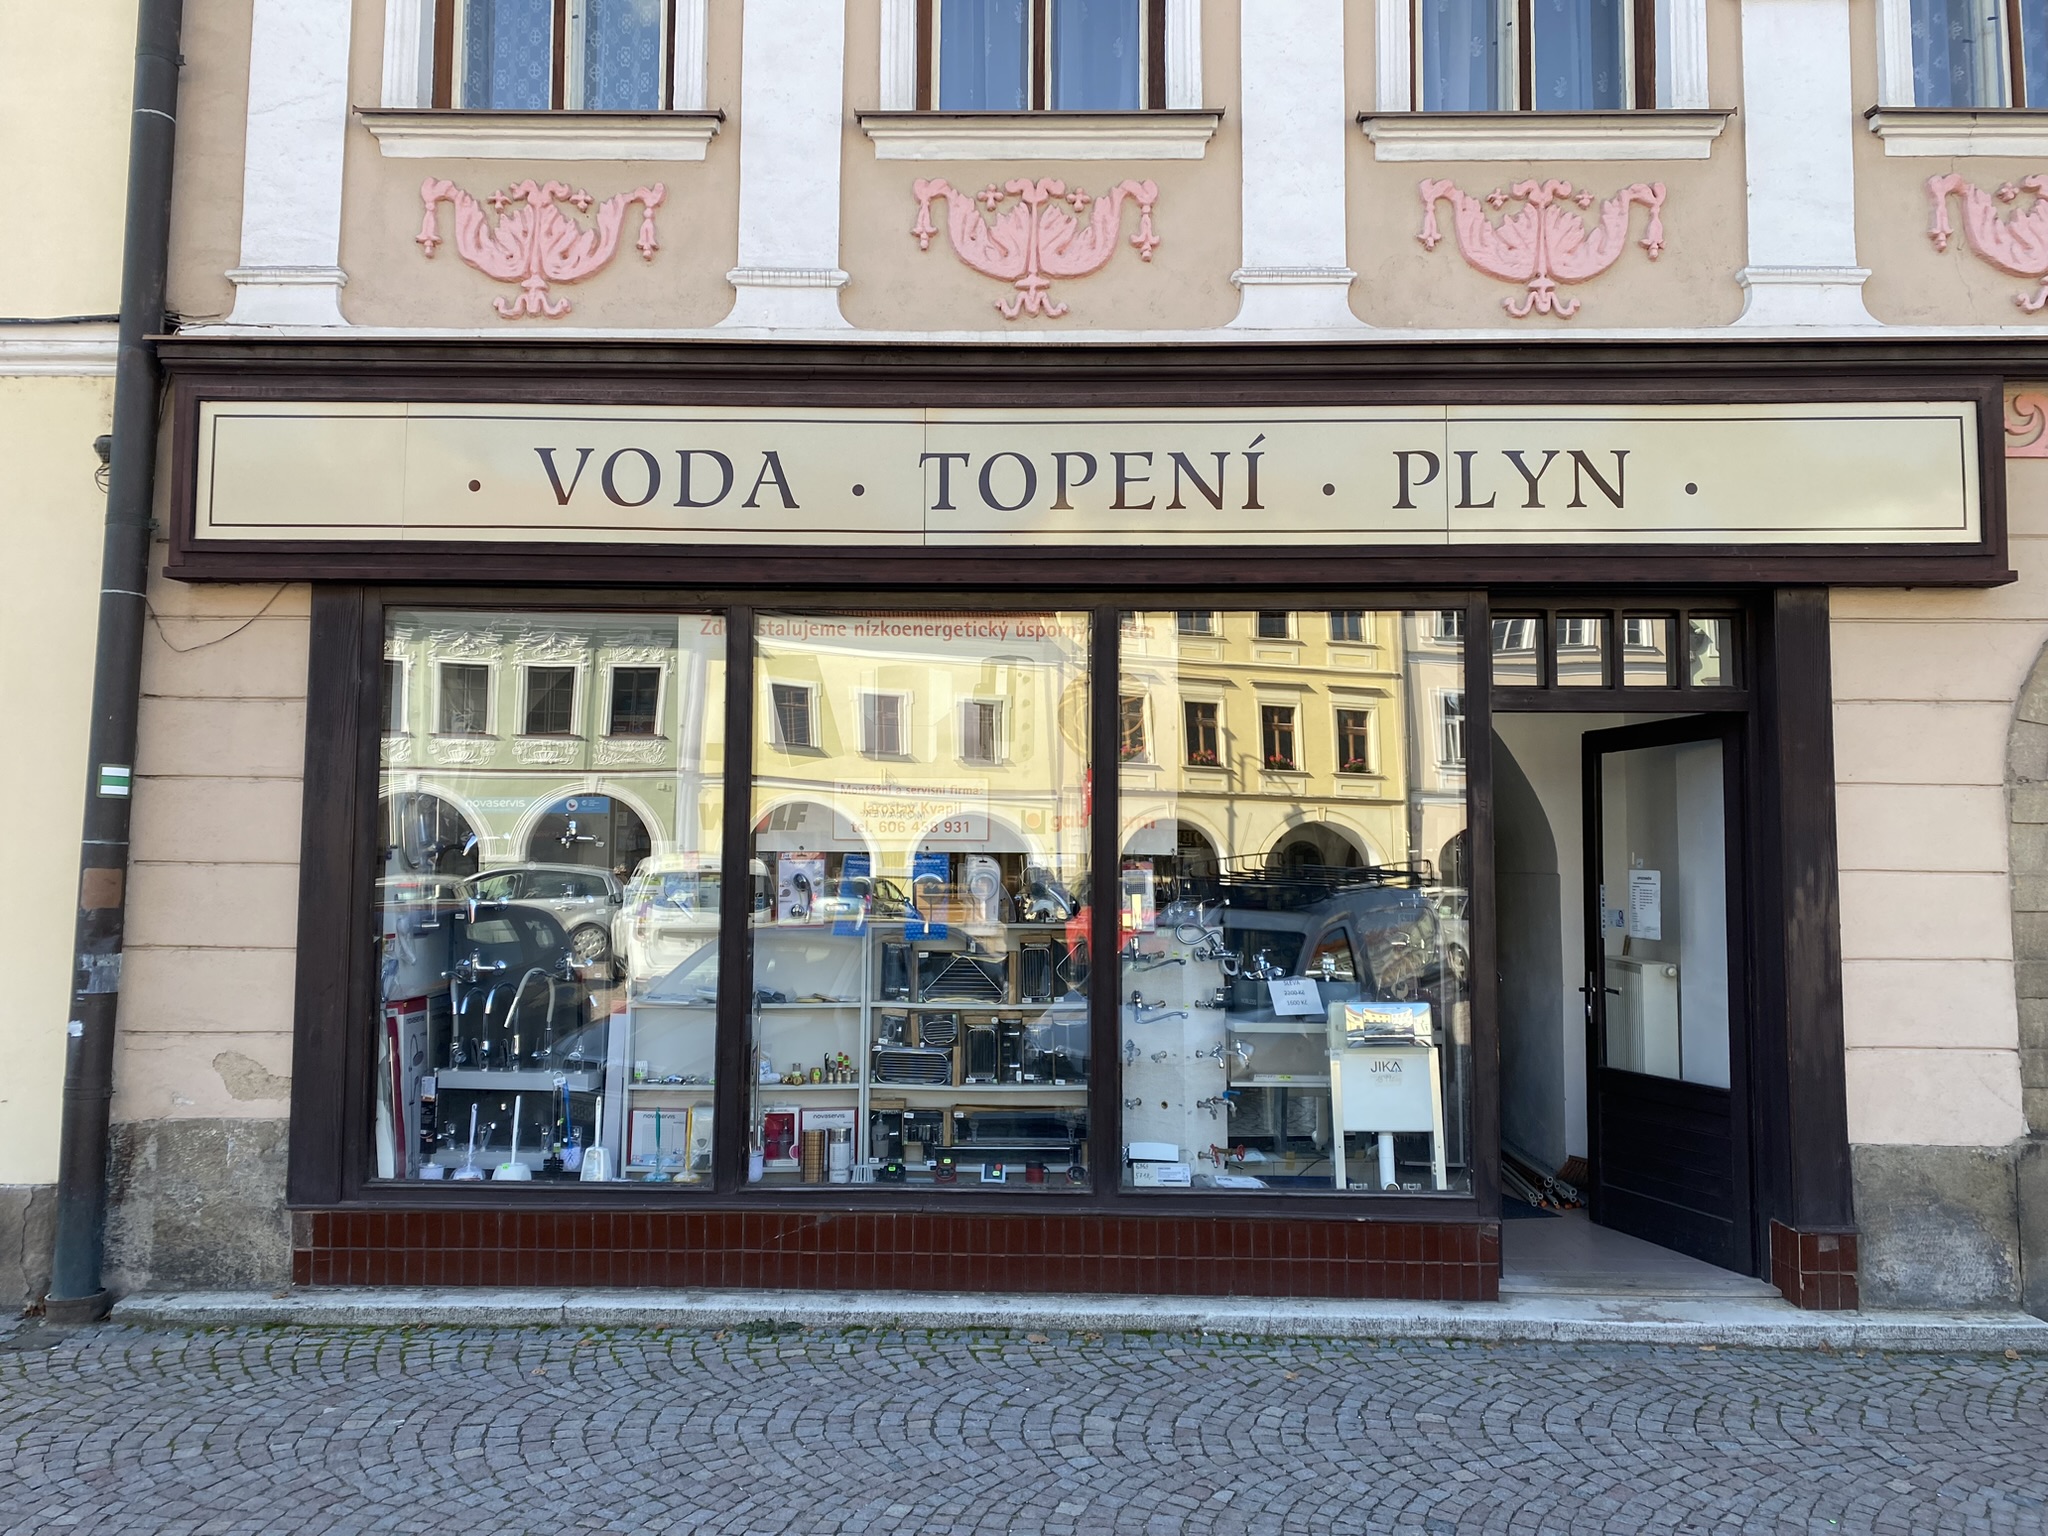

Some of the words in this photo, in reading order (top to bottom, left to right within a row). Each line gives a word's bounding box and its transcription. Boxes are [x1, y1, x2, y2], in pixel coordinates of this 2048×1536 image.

[534, 447, 800, 509] VODA
[919, 433, 1266, 511] TOPENÍ
[1392, 450, 1631, 509] PLYN
[854, 620, 1009, 642] nízkoenergetický
[840, 784, 892, 795] Montážní
[895, 787, 902, 795] a
[905, 784, 946, 795] servisní
[950, 784, 984, 796] firma:
[466, 799, 526, 809] novaservis
[920, 801, 963, 816] Kvapil
[850, 821, 873, 833] tel.
[878, 821, 906, 833] 606
[944, 821, 969, 833] 931
[1370, 1061, 1402, 1073] JIKA
